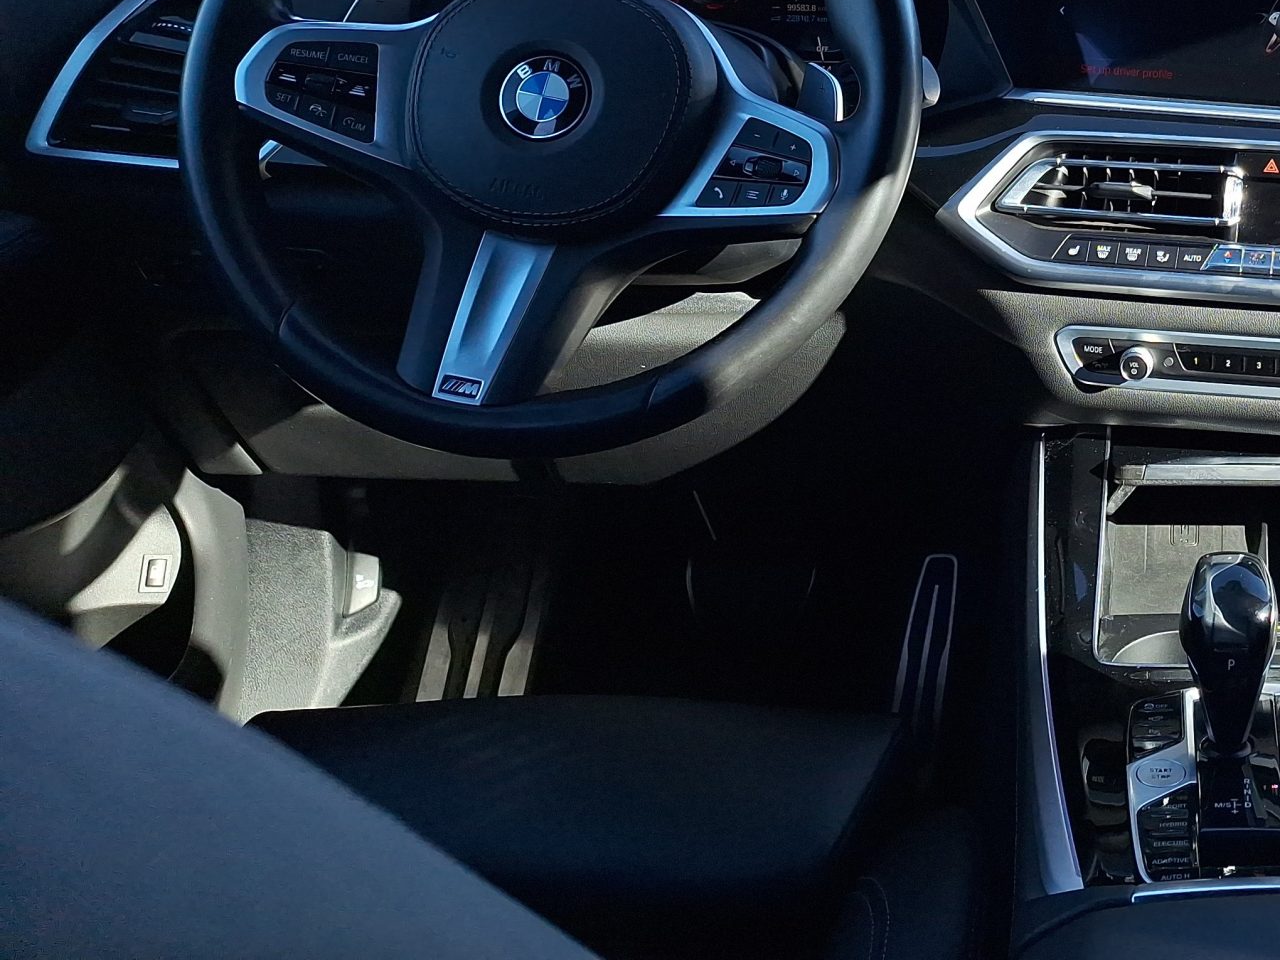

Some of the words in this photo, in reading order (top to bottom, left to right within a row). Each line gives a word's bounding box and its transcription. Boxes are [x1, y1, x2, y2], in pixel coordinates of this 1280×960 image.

[787, 4, 817, 12] 99583.8
[290, 48, 326, 59] RESUME
[338, 53, 368, 64] CANCEL
[517, 59, 582, 89] BMW
[276, 92, 291, 103] SET
[1125, 247, 1142, 255] REAR
[1183, 254, 1202, 262] AUTO
[1084, 345, 1103, 354] MODE
[1227, 658, 1236, 671] P
[1152, 857, 1188, 865] ADAPTIVE
[1161, 873, 1183, 881] AUTO
